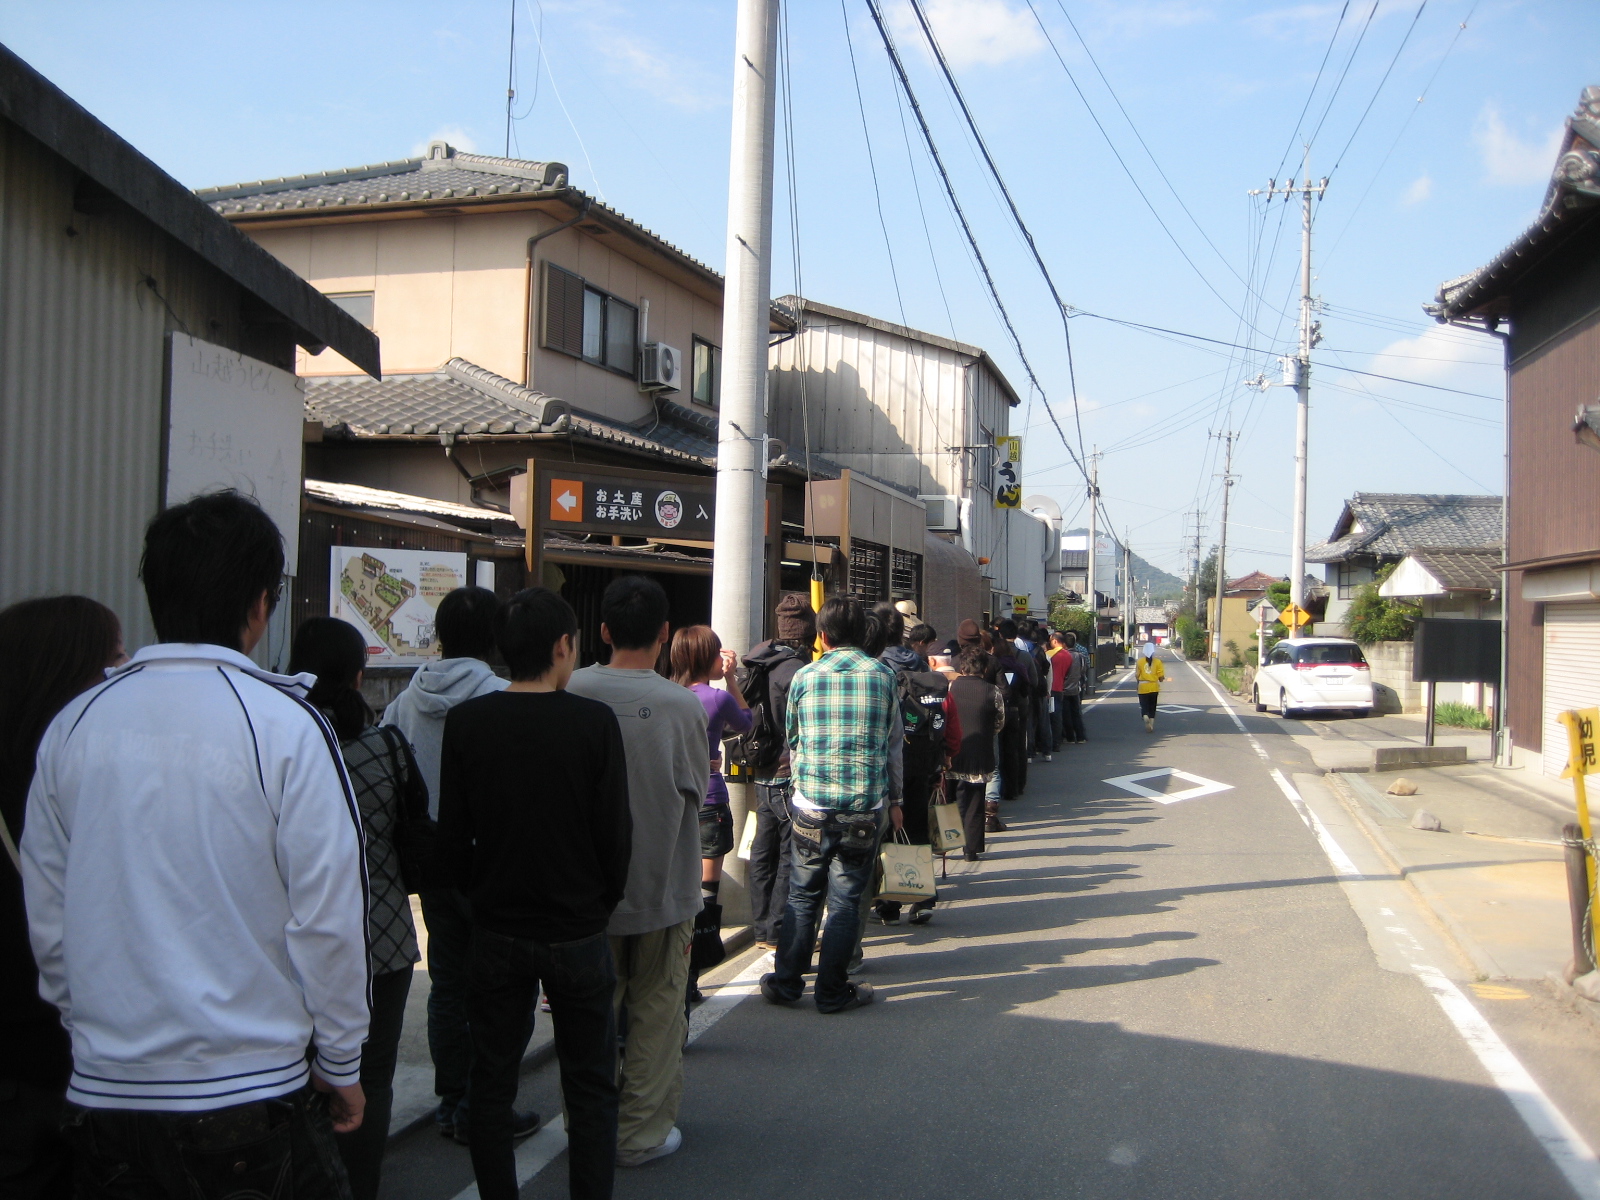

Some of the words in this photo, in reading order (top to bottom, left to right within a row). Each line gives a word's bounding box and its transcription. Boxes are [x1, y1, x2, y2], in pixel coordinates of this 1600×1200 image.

[192, 350, 276, 395] 山越うどん
[1010, 442, 1018, 460] 山越
[596, 489, 642, 505] お土産
[997, 462, 1020, 506] うどん
[595, 505, 642, 521] お手洗い
[1578, 716, 1596, 766] 幼児
